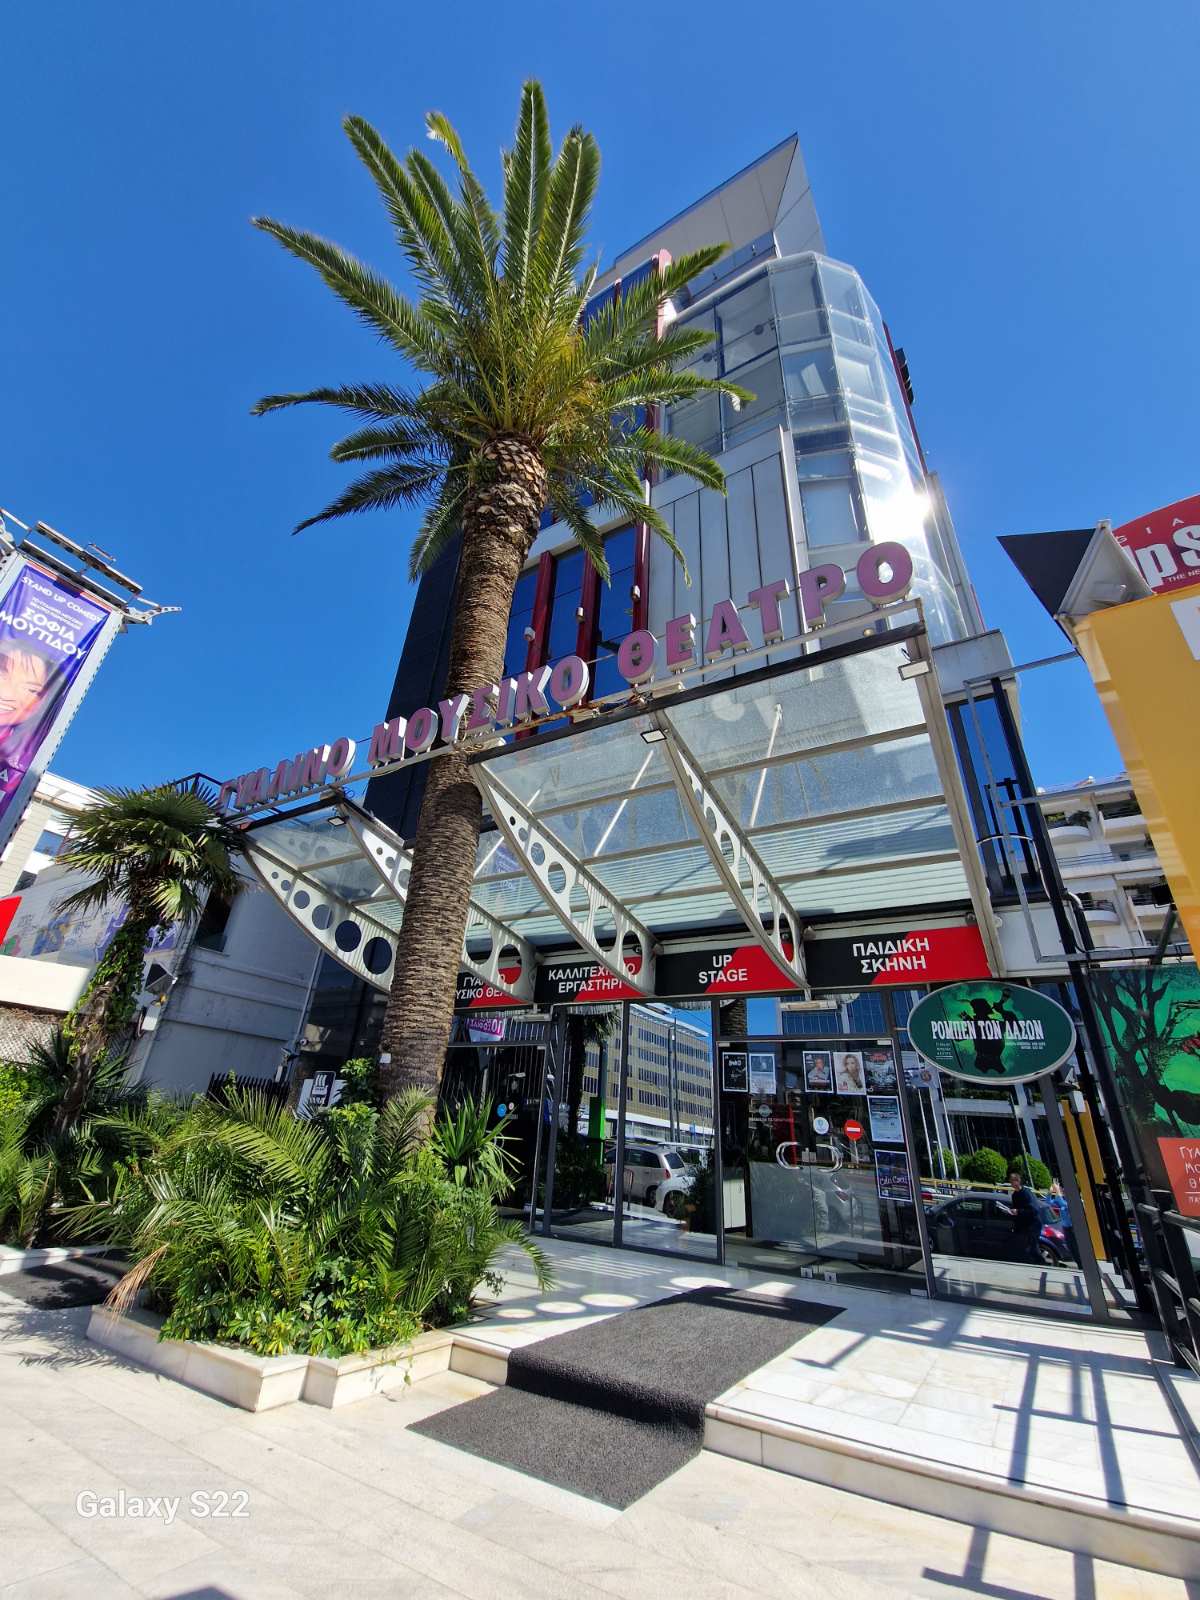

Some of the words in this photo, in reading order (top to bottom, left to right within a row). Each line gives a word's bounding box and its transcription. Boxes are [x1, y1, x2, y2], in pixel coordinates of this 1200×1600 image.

[21, 576, 53, 597] STAND
[53, 594, 67, 603] UP
[67, 601, 102, 622] COMEDY
[0, 610, 87, 660] ΜΟΥΤΙΔΟΥ
[20, 607, 75, 642] ΣΟΦΙΑ
[367, 656, 589, 766] ΜΟΥΣΙΚΟ
[617, 541, 914, 684] ΘΕΑΤΡΟ
[852, 937, 930, 957] ΠΑΙΔΙΚΗ
[712, 954, 733, 967] UP
[861, 955, 927, 974] ΣΚΗΝΗ
[698, 968, 748, 984] STAGE
[931, 1020, 977, 1040] ΡΟΜΠΕΝ
[978, 1020, 1003, 1040] ΤΩΝ
[1005, 1019, 1045, 1040] ΔΑΣΩΝ
